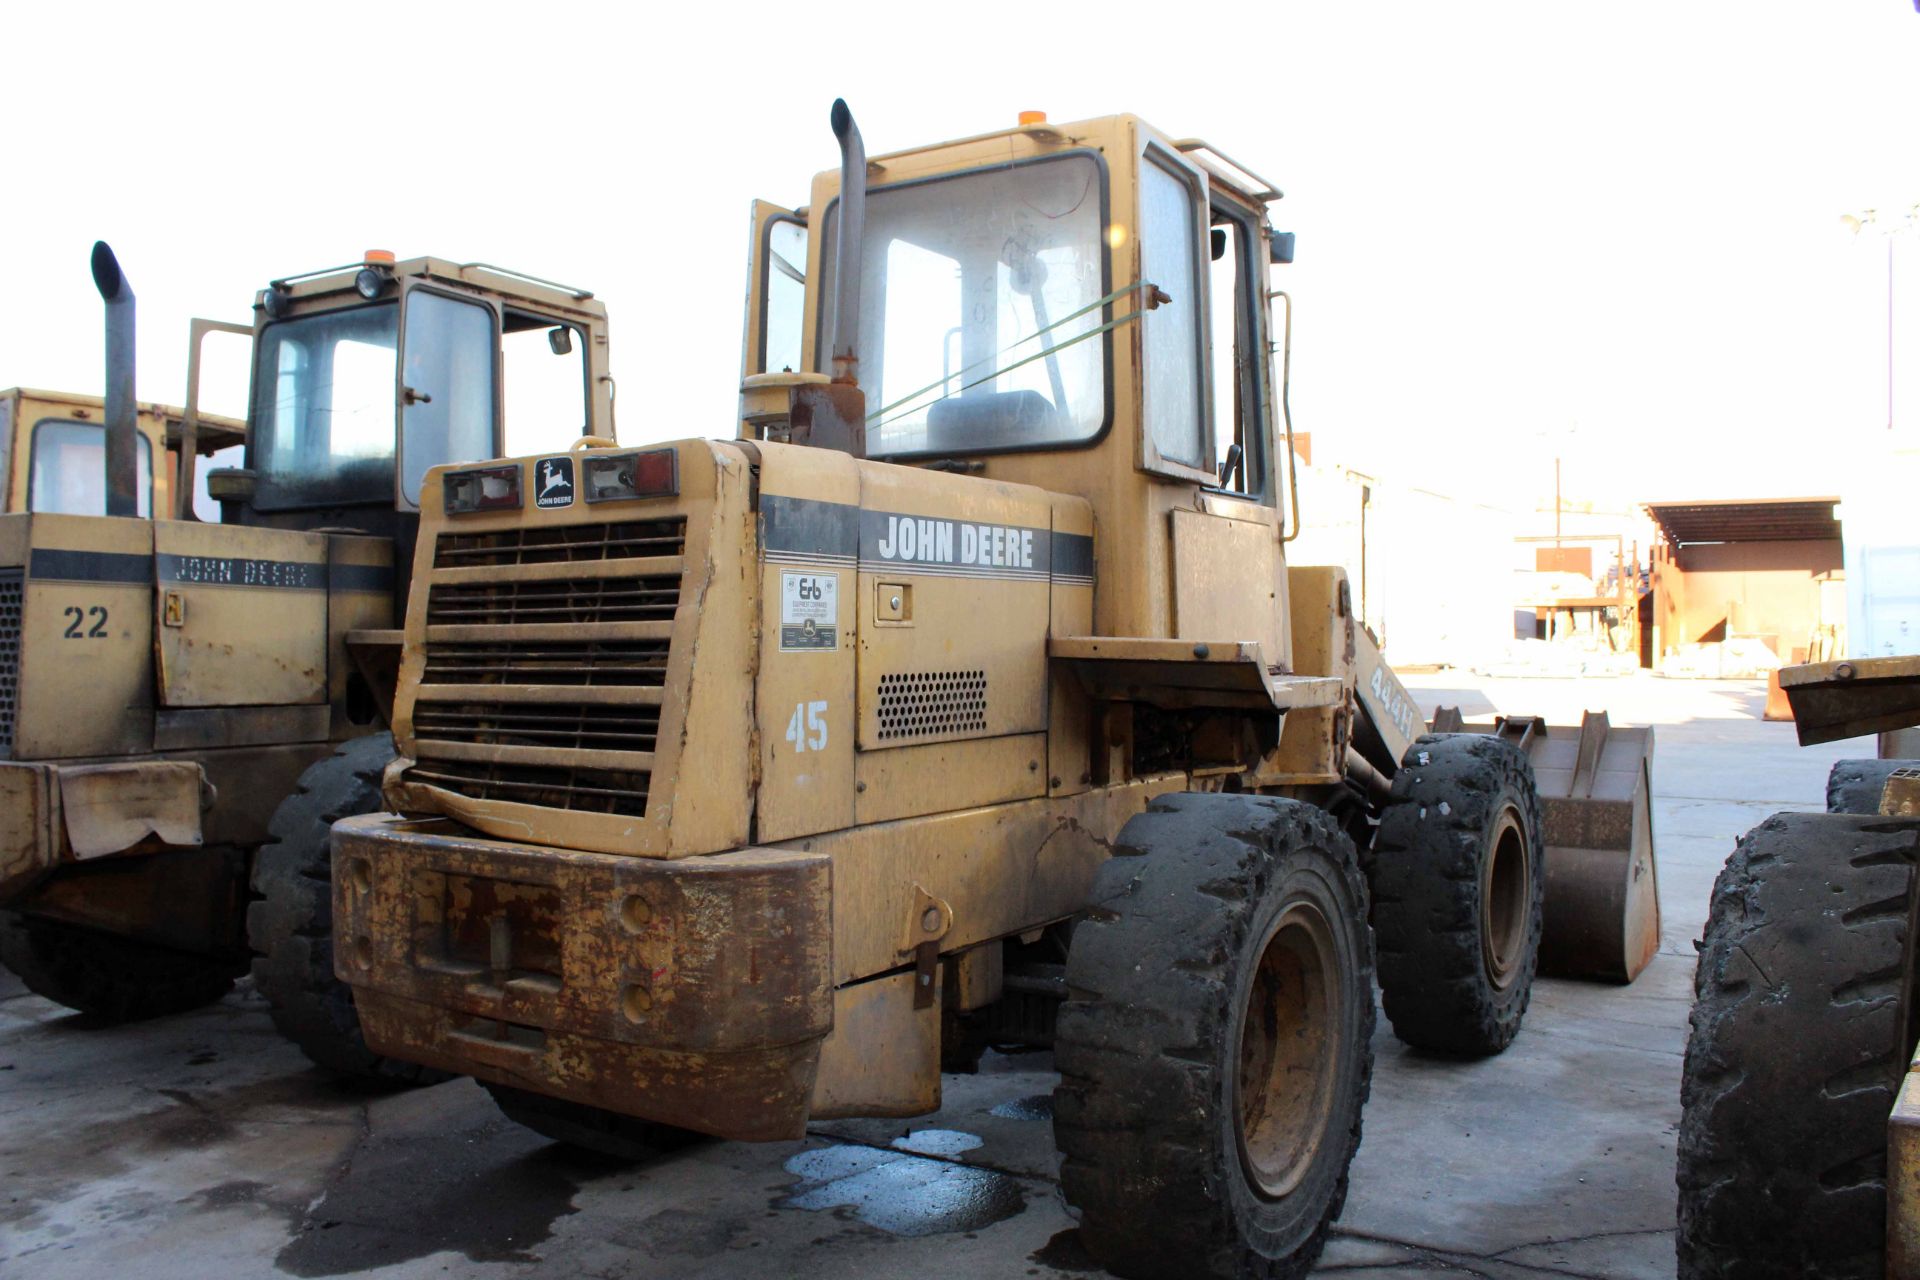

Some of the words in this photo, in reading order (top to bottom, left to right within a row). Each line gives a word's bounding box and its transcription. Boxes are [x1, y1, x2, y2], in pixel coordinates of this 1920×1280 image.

[538, 497, 553, 505] JOHN
[553, 495, 572, 504] DEERE
[878, 516, 953, 563] JOHN
[961, 523, 1033, 568] DEERE
[176, 557, 232, 582] JOHN
[244, 561, 307, 587] DEERE
[64, 606, 108, 639] 22
[1371, 666, 1413, 739] 444H
[785, 700, 828, 752] 45
